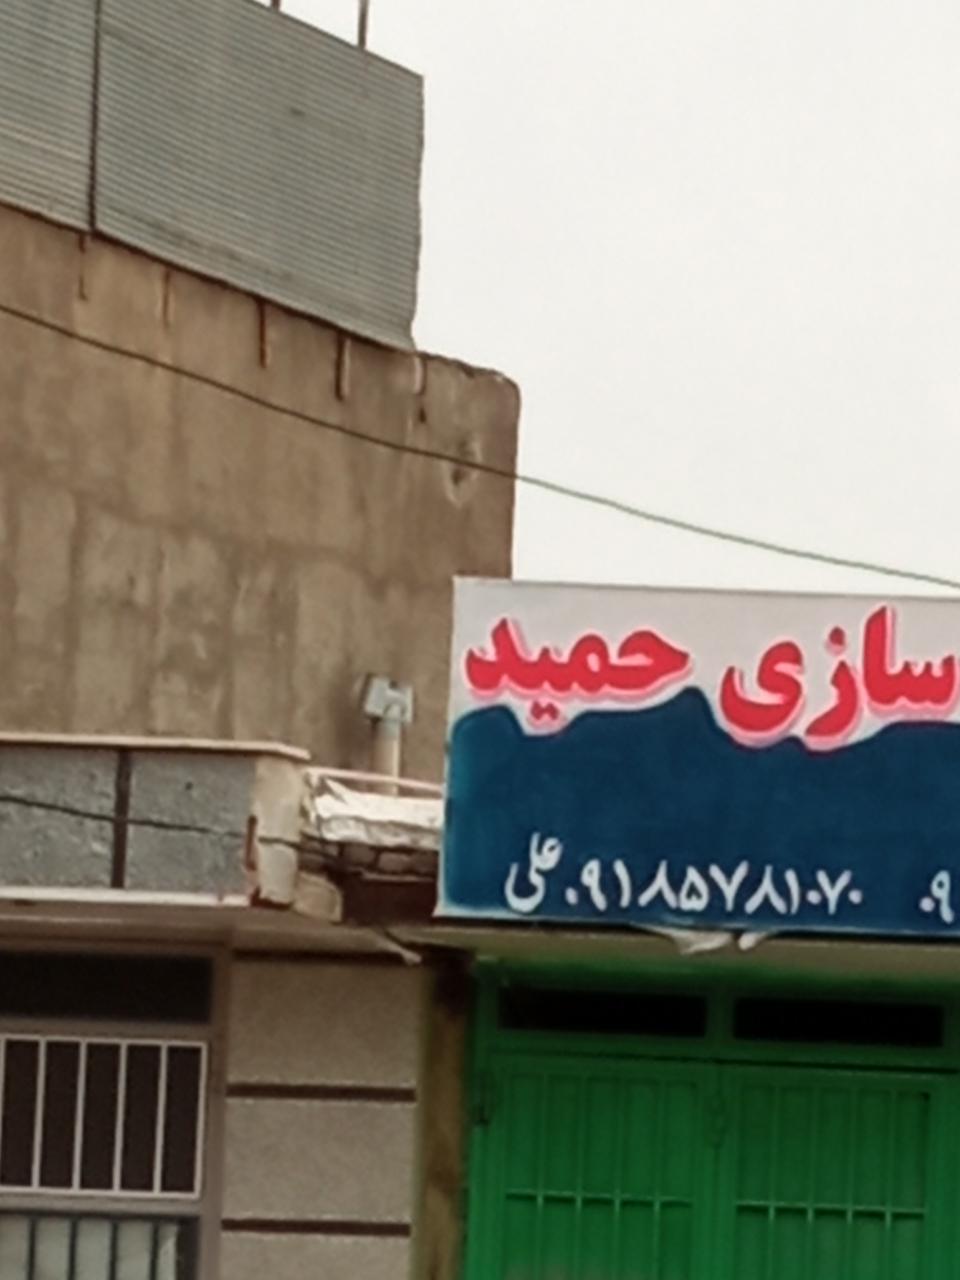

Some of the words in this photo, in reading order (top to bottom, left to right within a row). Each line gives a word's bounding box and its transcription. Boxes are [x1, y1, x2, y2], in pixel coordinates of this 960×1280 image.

[464, 617, 692, 724] حمید
[719, 605, 959, 740] سازی
[505, 831, 563, 914] علی
